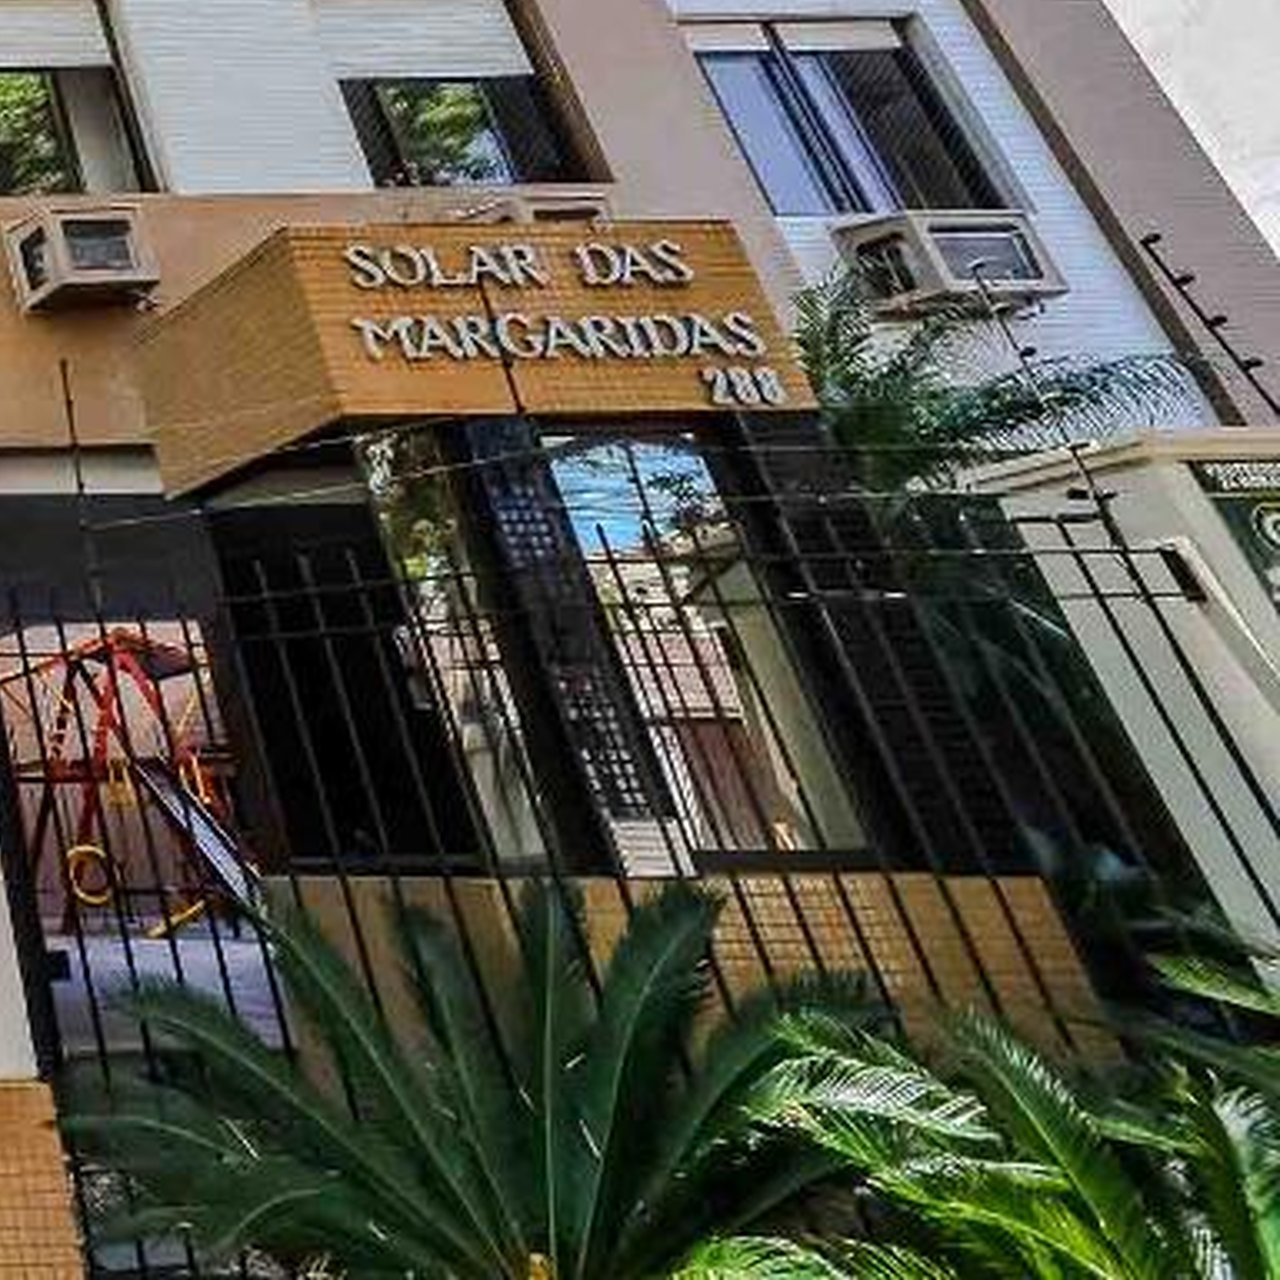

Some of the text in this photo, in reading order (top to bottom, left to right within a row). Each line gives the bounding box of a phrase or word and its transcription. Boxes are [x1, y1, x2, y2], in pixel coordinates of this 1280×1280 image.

[345, 238, 694, 288] SOLAR DAS
[351, 311, 768, 361] MARGARIDAS
